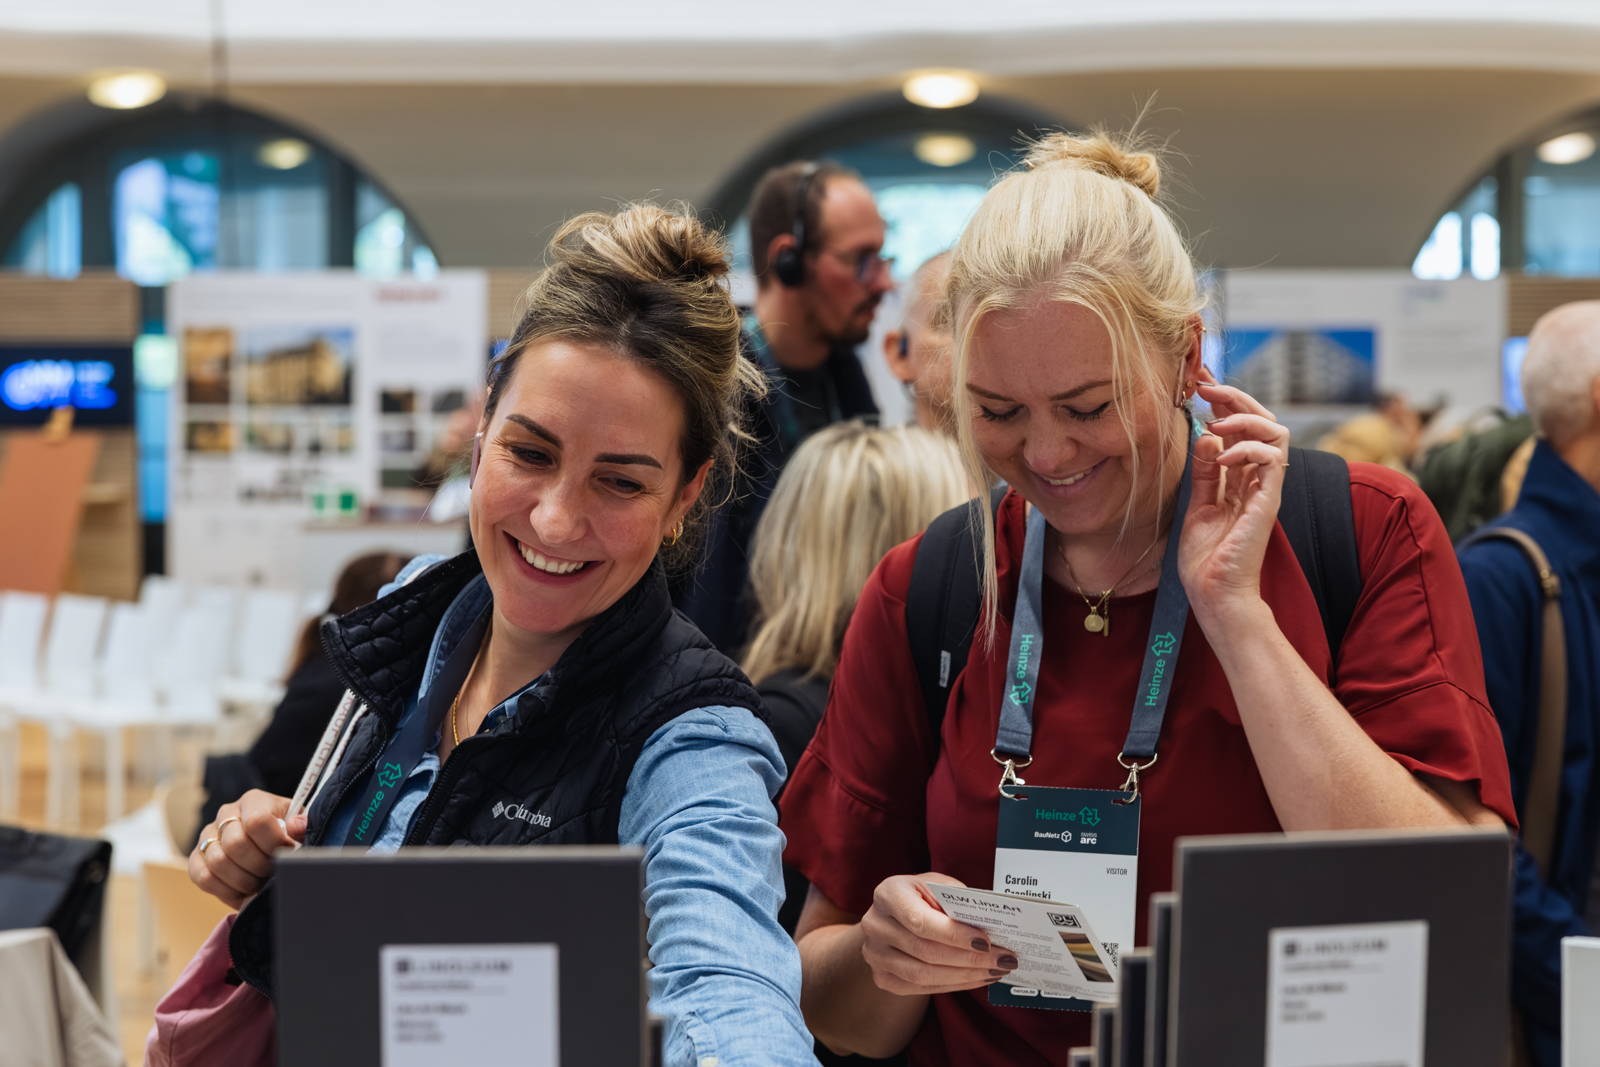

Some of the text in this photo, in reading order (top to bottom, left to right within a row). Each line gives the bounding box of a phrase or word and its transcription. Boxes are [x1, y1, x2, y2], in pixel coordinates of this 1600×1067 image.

[1016, 634, 1034, 679] Heinze
[1145, 658, 1166, 707] Heinze
[354, 789, 385, 842] Heinze
[503, 803, 552, 828] Clumbia
[1035, 808, 1077, 821] Heinze
[1034, 831, 1060, 839] BauNetz
[1080, 837, 1097, 845] arc
[1005, 874, 1038, 886] Carolin
[1106, 867, 1128, 876] VISITOR
[941, 892, 1023, 913] DLW Lino Art
